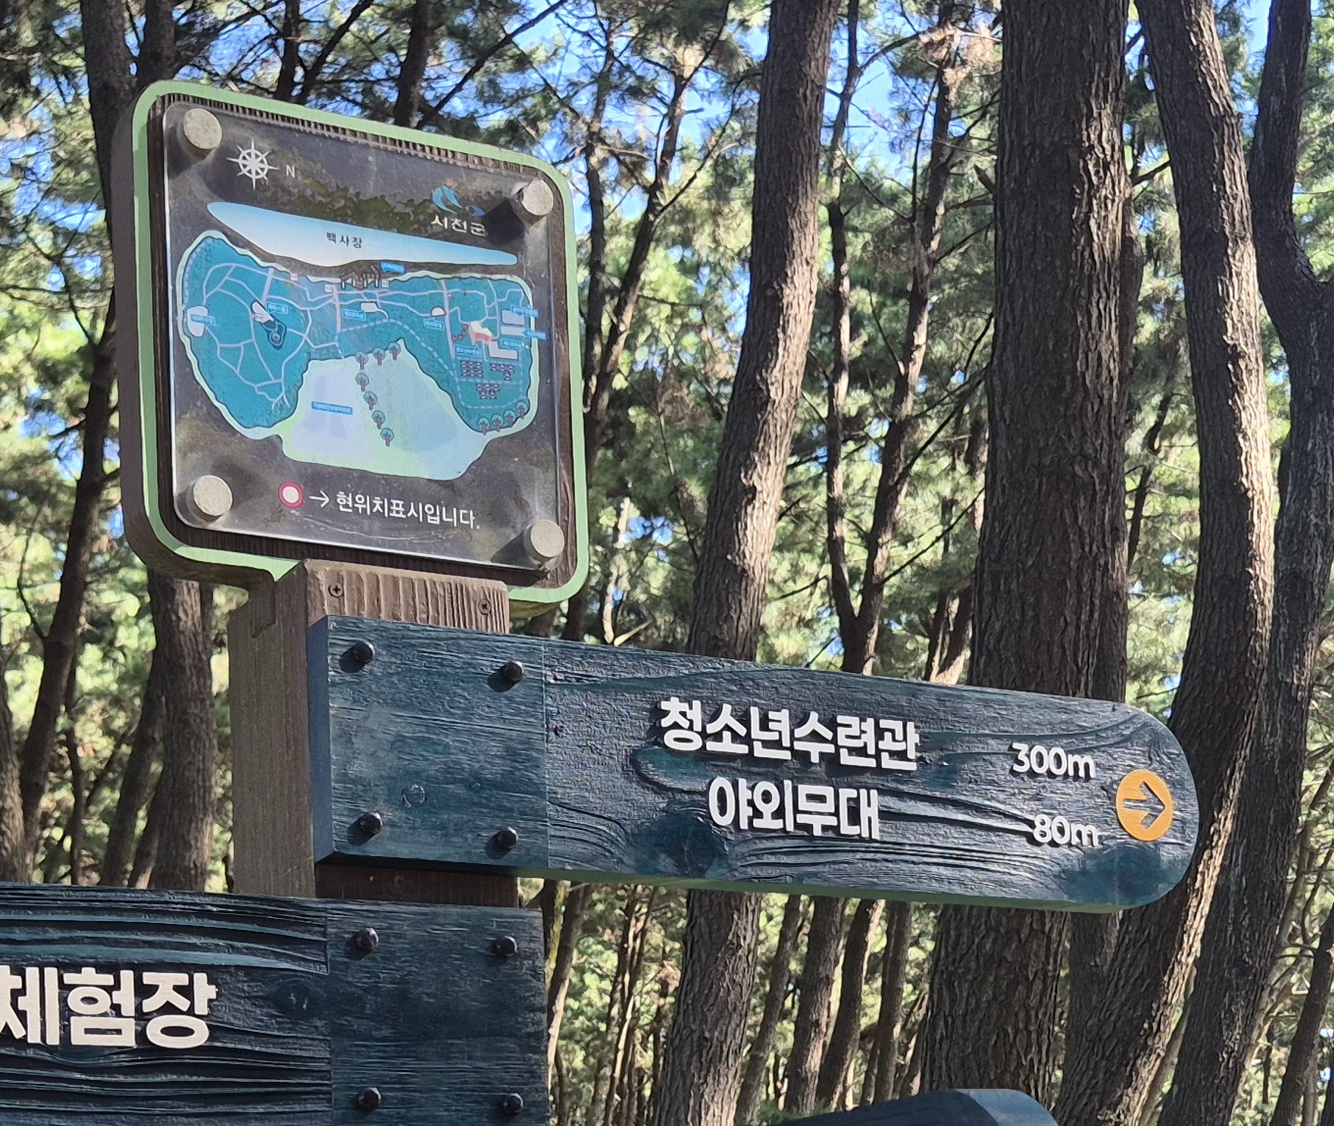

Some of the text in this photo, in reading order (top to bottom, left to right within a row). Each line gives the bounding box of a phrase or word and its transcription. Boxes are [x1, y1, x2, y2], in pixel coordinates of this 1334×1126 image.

[285, 164, 297, 178] N
[326, 231, 363, 249] 백사장
[430, 214, 488, 237] 서천군
[336, 491, 480, 530] 현위치표시입니다.
[660, 697, 1096, 780] 청소년수련관 300m
[708, 777, 1099, 847] 야외무대 80m
